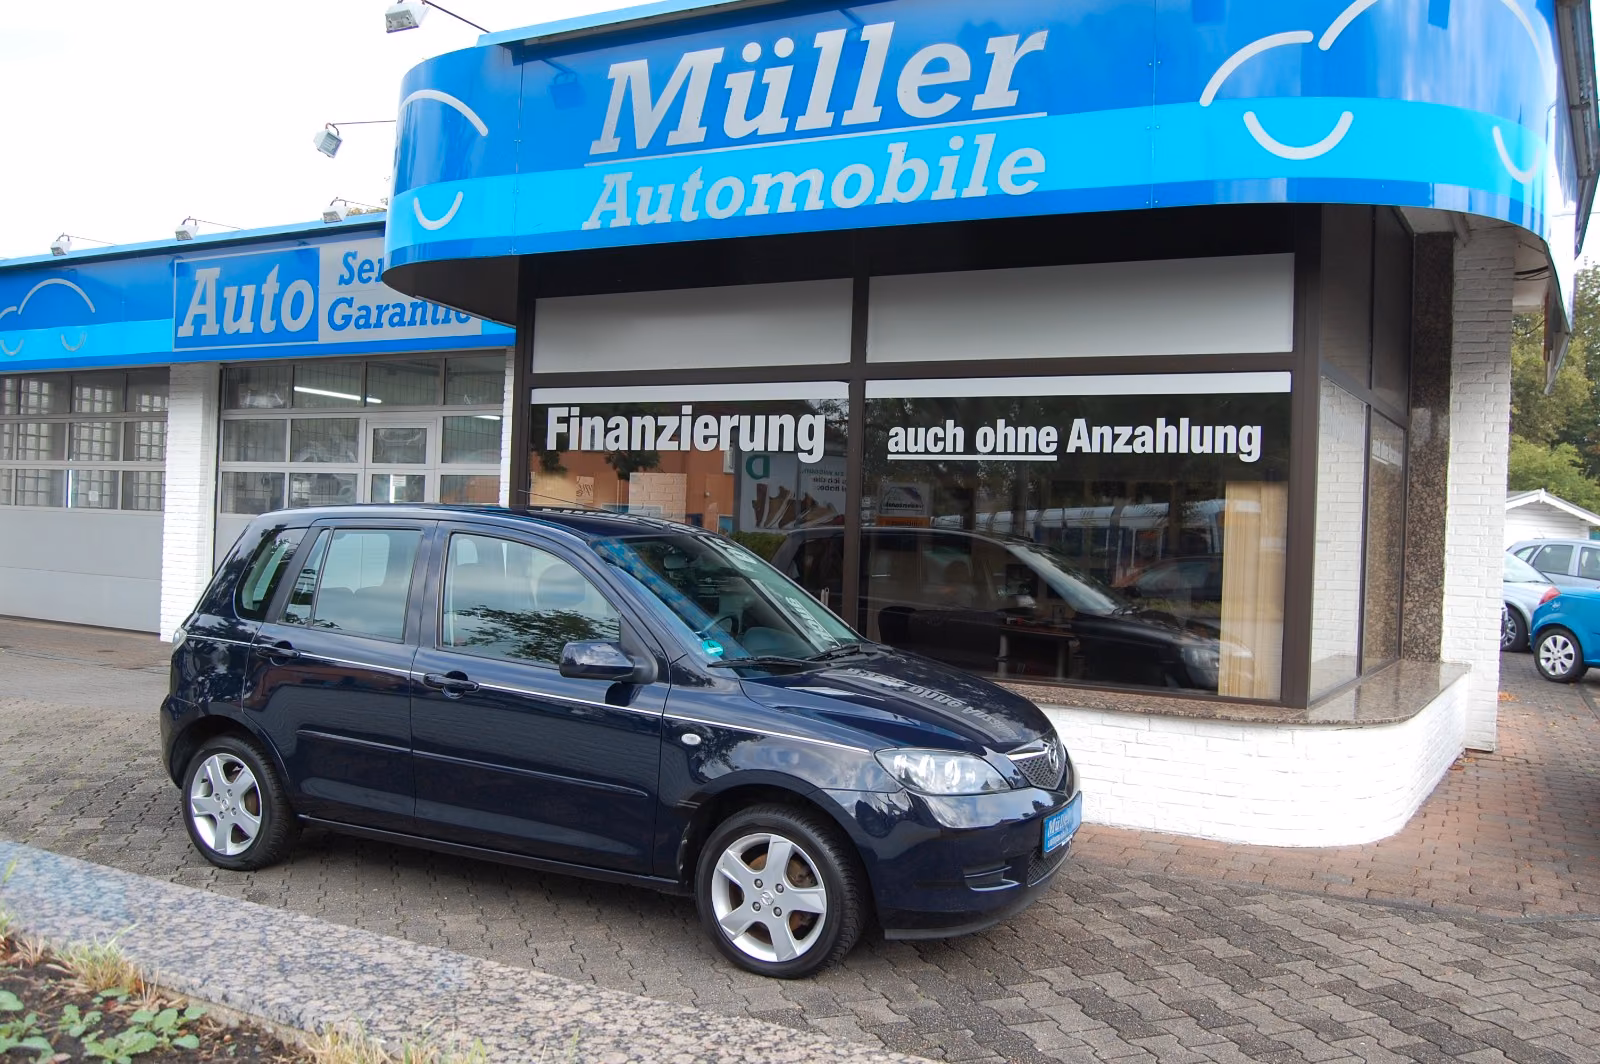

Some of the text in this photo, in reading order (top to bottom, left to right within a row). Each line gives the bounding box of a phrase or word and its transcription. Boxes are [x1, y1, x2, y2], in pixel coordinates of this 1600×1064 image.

[590, 21, 1048, 155] Müller
[581, 132, 1046, 231] Automobile
[177, 263, 315, 337] Auto
[547, 404, 826, 464] Finanzierung
[887, 417, 1262, 463] auch ohne Anzahlung
